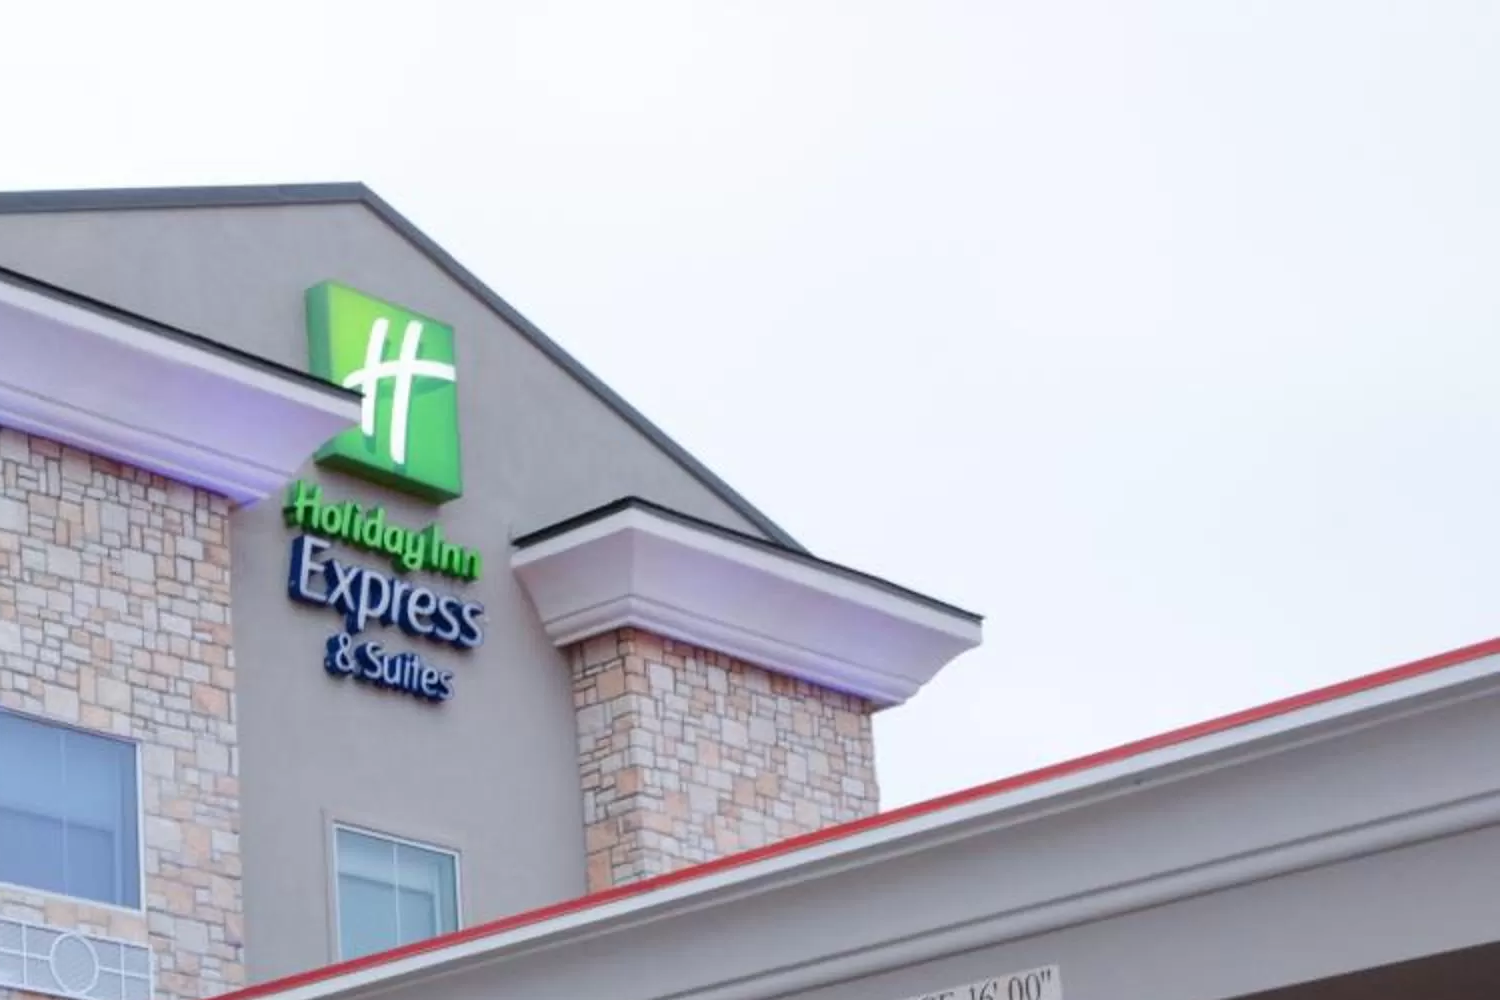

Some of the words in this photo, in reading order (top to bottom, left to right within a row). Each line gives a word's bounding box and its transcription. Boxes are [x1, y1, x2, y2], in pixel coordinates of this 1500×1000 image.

[292, 479, 425, 571] Holiday
[430, 523, 483, 580] Inn
[298, 536, 484, 647] Express
[335, 633, 355, 673] &
[366, 643, 455, 698] Suites
